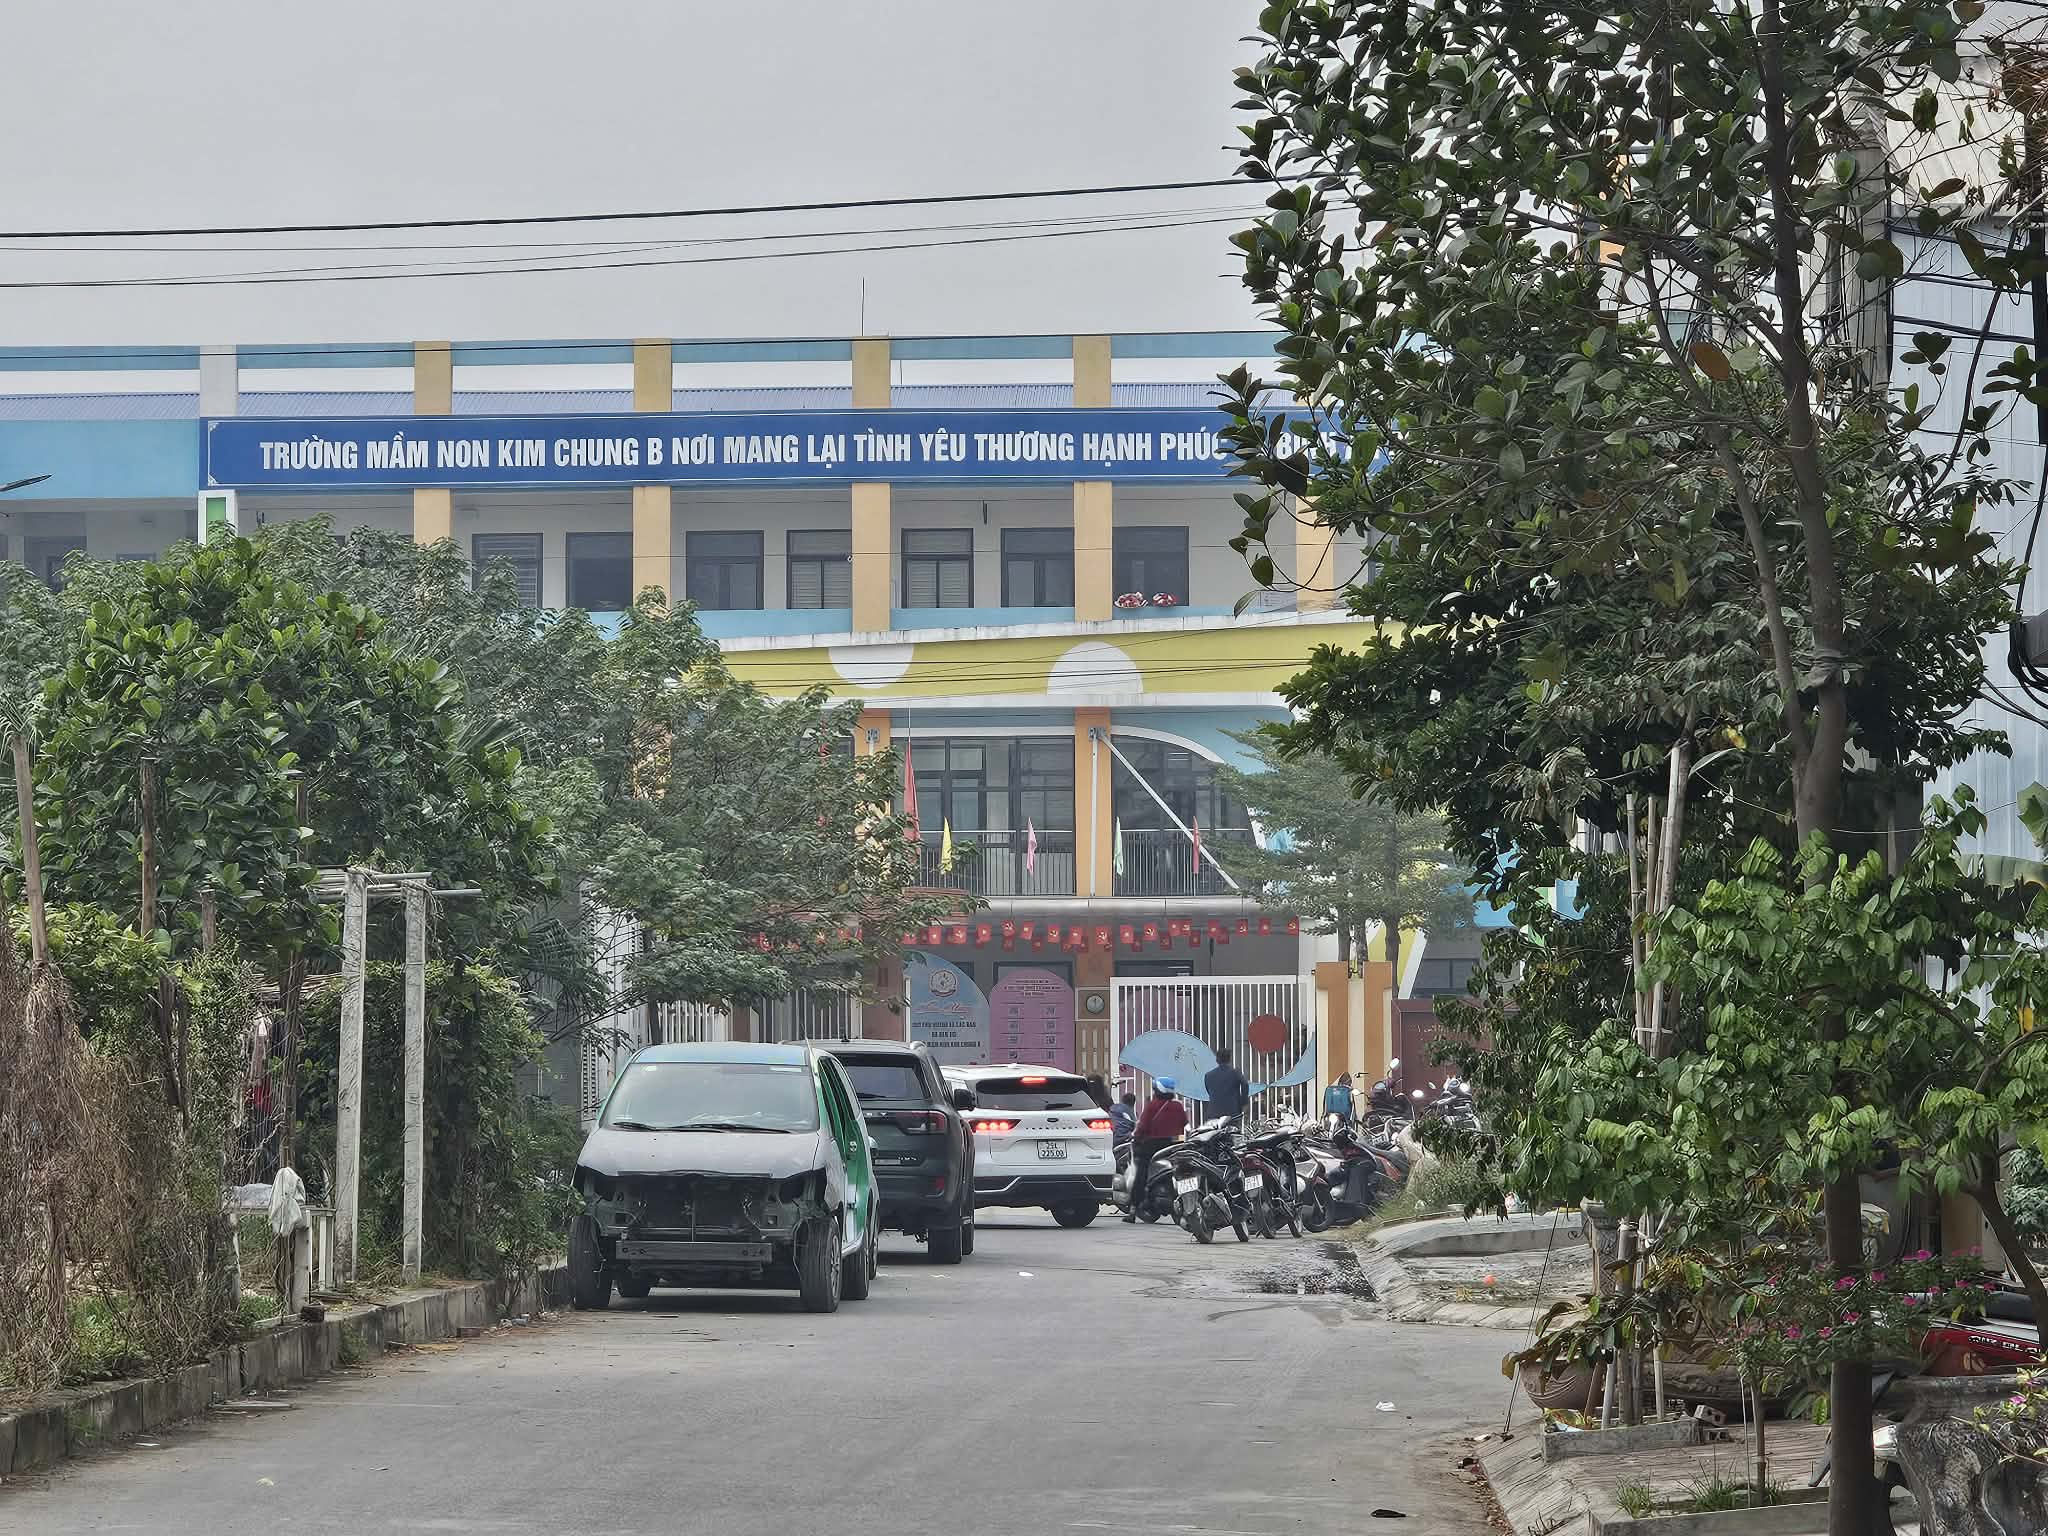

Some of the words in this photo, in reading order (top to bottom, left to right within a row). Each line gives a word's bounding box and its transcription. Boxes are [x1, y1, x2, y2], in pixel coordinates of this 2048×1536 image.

[259, 432, 359, 470] TRƯỜNG
[366, 430, 429, 470] MẦM
[436, 439, 490, 469] NON
[497, 438, 546, 467] KIM
[553, 437, 640, 468] CHUNG
[647, 437, 664, 466] B
[671, 433, 715, 465] NƠI
[723, 434, 799, 465] MANG
[807, 433, 846, 469] LẠI
[853, 427, 911, 464] TÌNH
[918, 427, 967, 462] YÊU
[973, 430, 1075, 463] THƯƠNG
[1082, 431, 1152, 468] HẠNH
[1160, 425, 1232, 462] PHÚC
